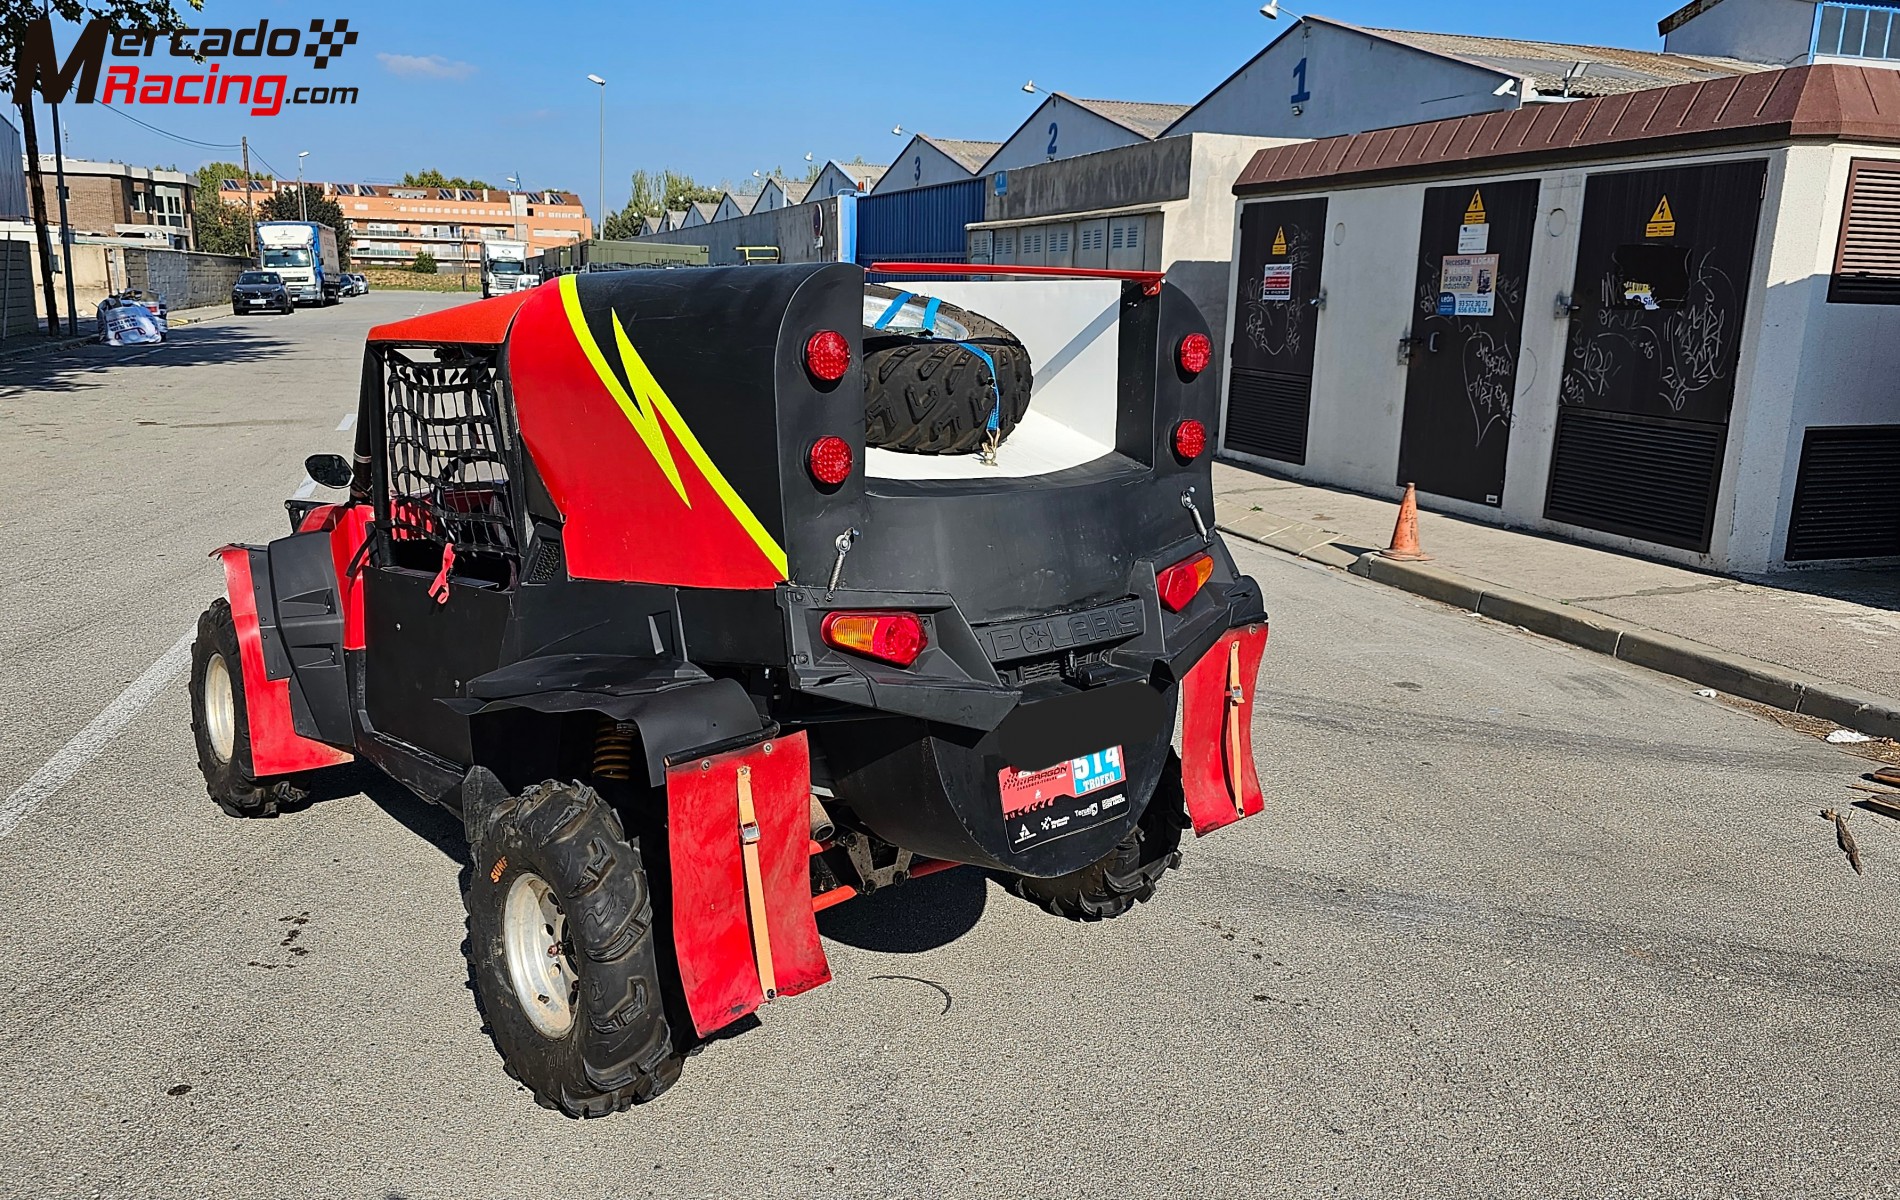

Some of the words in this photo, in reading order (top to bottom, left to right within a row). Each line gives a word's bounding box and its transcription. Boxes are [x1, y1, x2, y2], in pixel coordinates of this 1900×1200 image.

[1291, 57, 1310, 104] 1
[1047, 122, 1058, 154] 2
[914, 156, 921, 181] 3
[1444, 258, 1470, 266] Necessita
[1471, 256, 1496, 265] LLOGAR
[1443, 282, 1470, 290] industrial?
[990, 605, 1139, 660] POLARIS
[1083, 771, 1116, 792] TROFEO
[490, 855, 508, 883] SUNF
